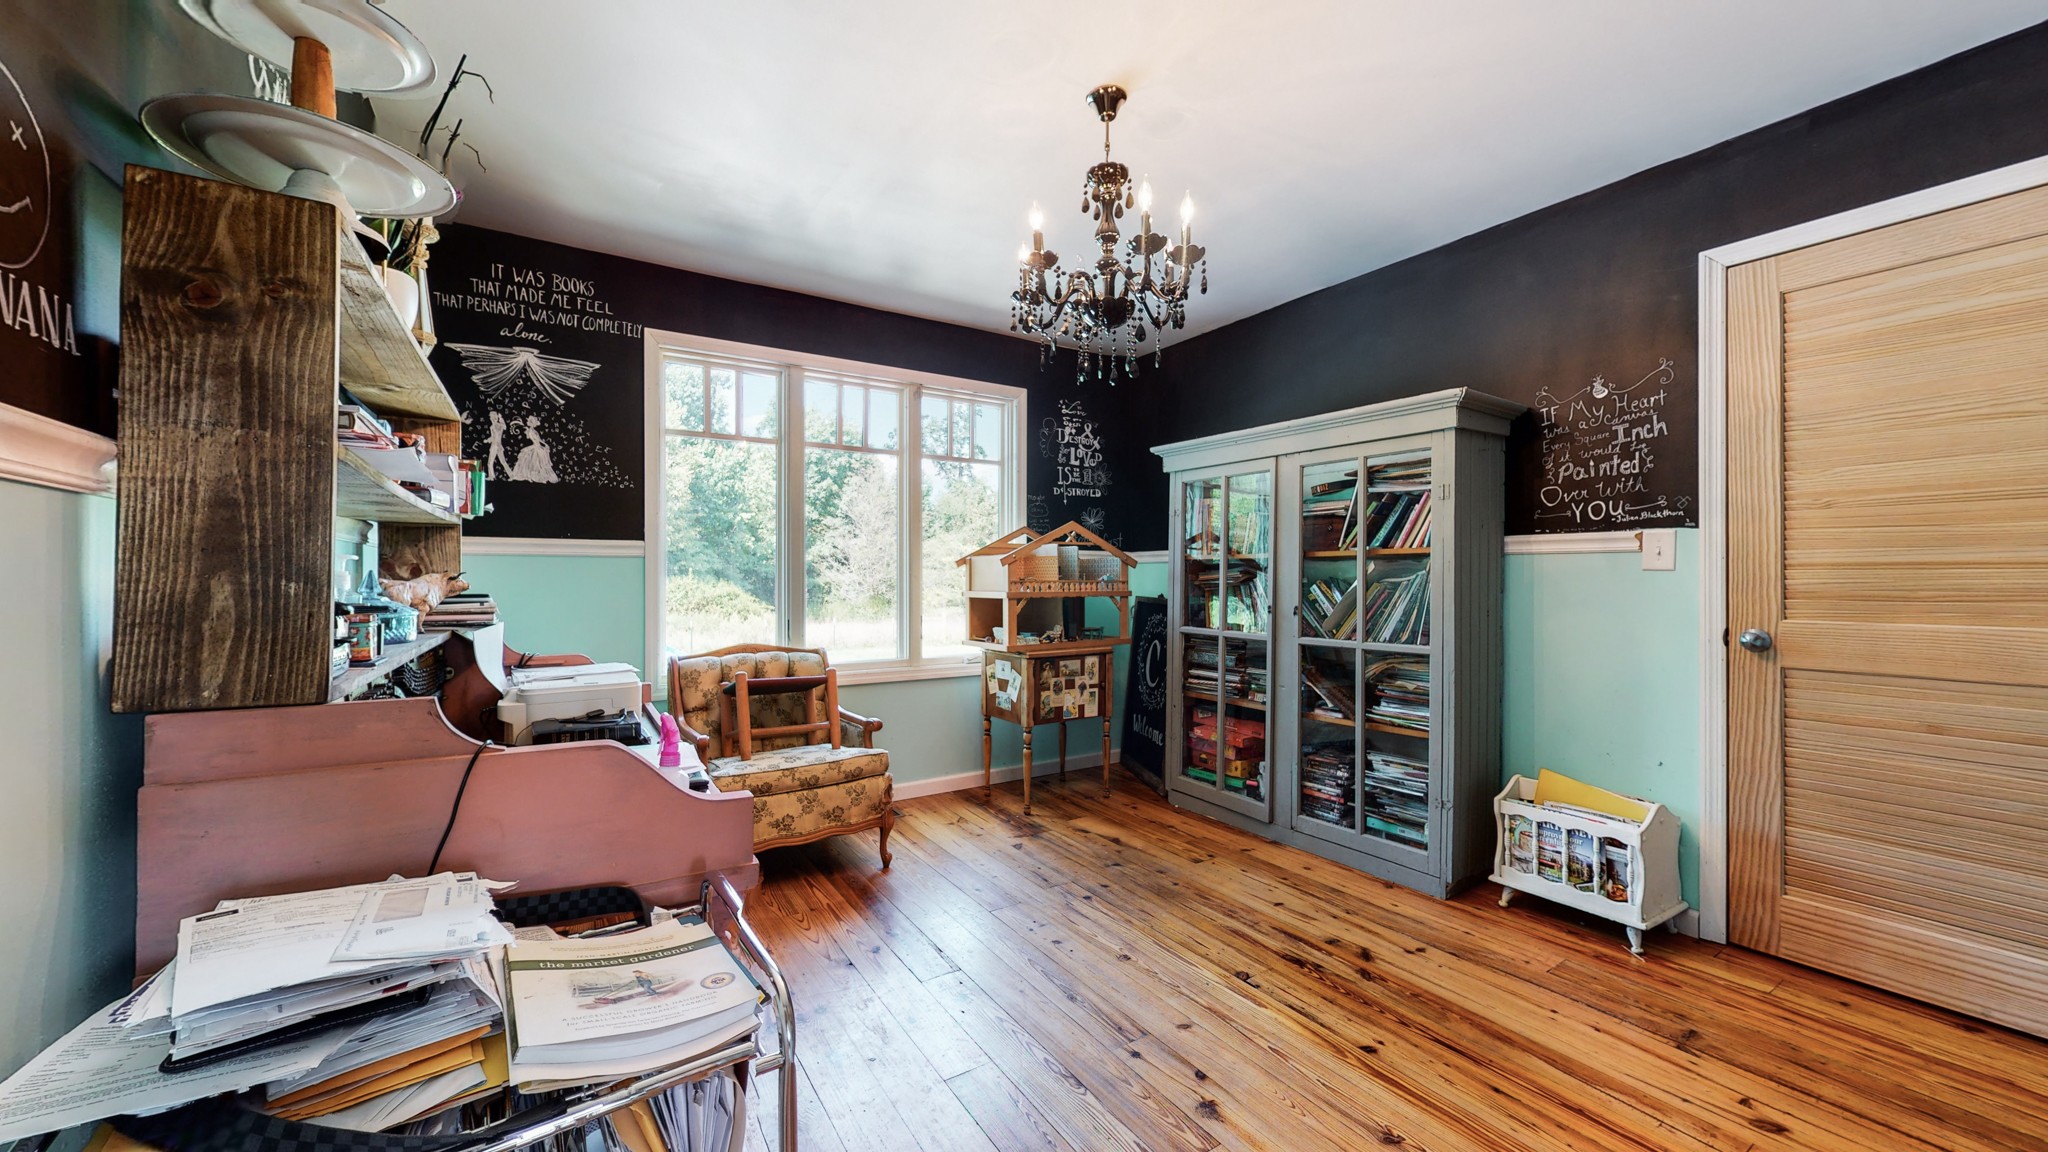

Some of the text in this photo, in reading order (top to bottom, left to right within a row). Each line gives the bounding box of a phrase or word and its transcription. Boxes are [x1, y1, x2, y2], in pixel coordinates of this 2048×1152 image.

[469, 277, 614, 315] THAT MADE ME FEEL
[491, 263, 595, 296] IT WAS BOOKS
[433, 291, 643, 338] THAT PERHAPS I WAS NOT COMPLETELY
[500, 322, 553, 344] alone.
[1568, 400, 1604, 427] My
[1611, 389, 1668, 417] Heart
[1543, 426, 1570, 439] was
[1578, 420, 1589, 429] a
[1543, 414, 1668, 453] Every Square Inch
[1558, 451, 1640, 485] Painted
[1579, 443, 1621, 460] would
[1541, 486, 1590, 507] Over
[539, 944, 695, 969] the market gardener
